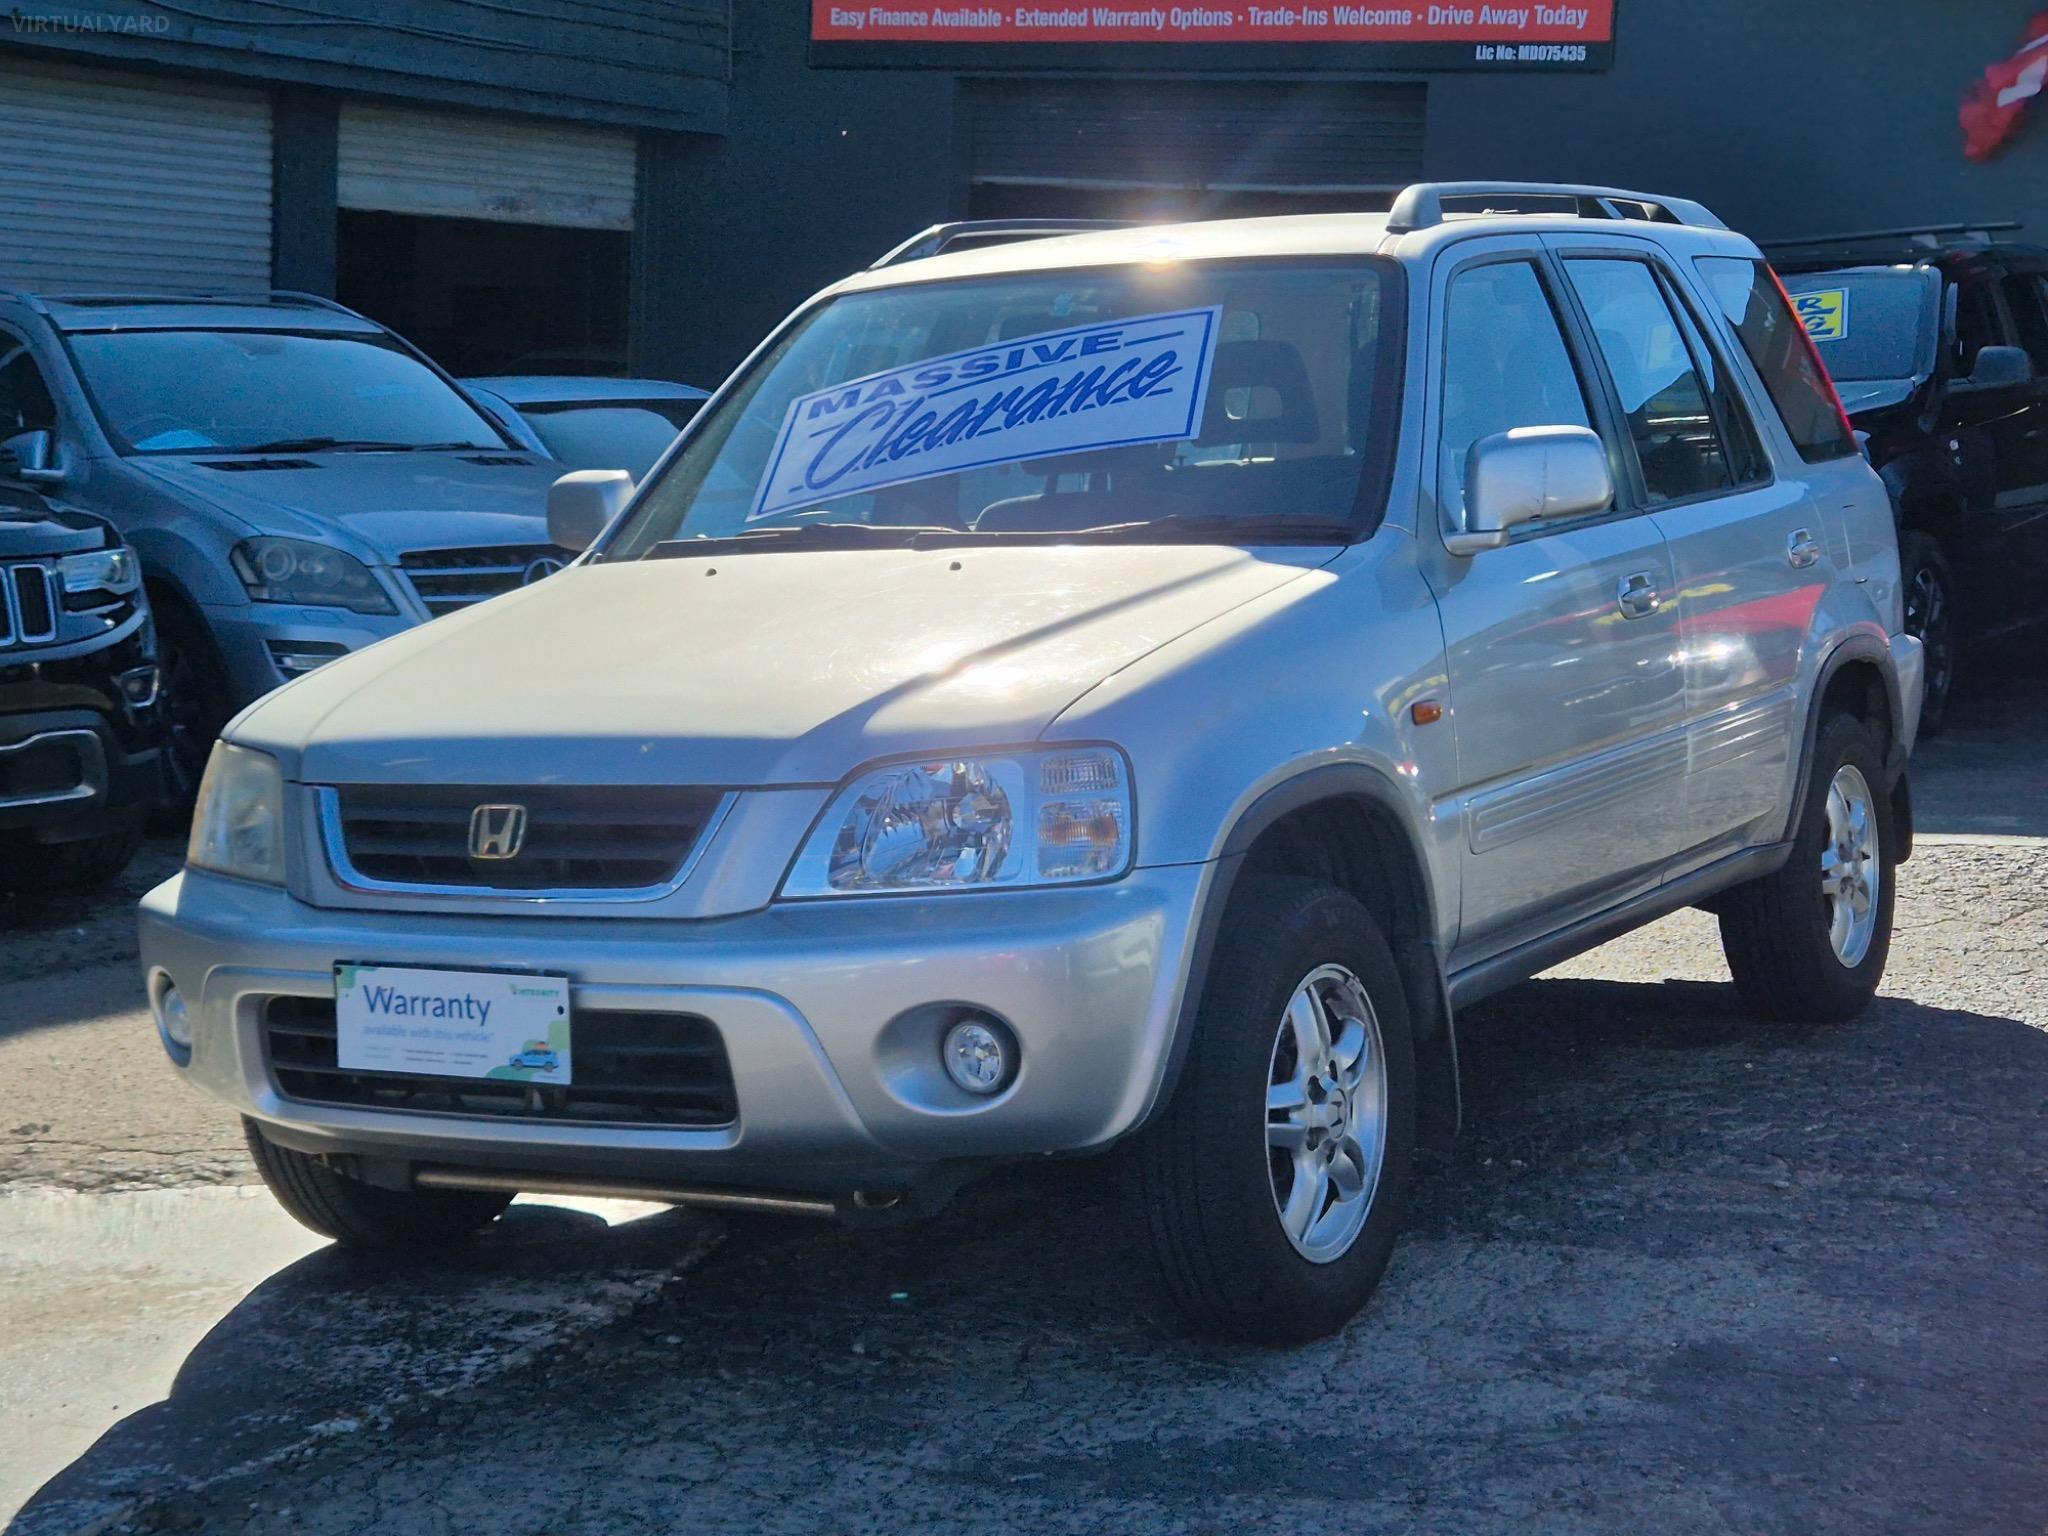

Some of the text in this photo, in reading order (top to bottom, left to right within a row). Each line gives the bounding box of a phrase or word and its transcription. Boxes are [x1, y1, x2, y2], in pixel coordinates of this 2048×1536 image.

[830, 5, 1588, 30] Easy Finance Available Extended Warranty Options Trade-Ins Welcome Drive Away Today
[1475, 45, 1586, 61] Lic No: MD075435
[806, 330, 1124, 421] MASSIVE
[804, 349, 1185, 490] Clearance
[362, 984, 491, 1027] Warranty
